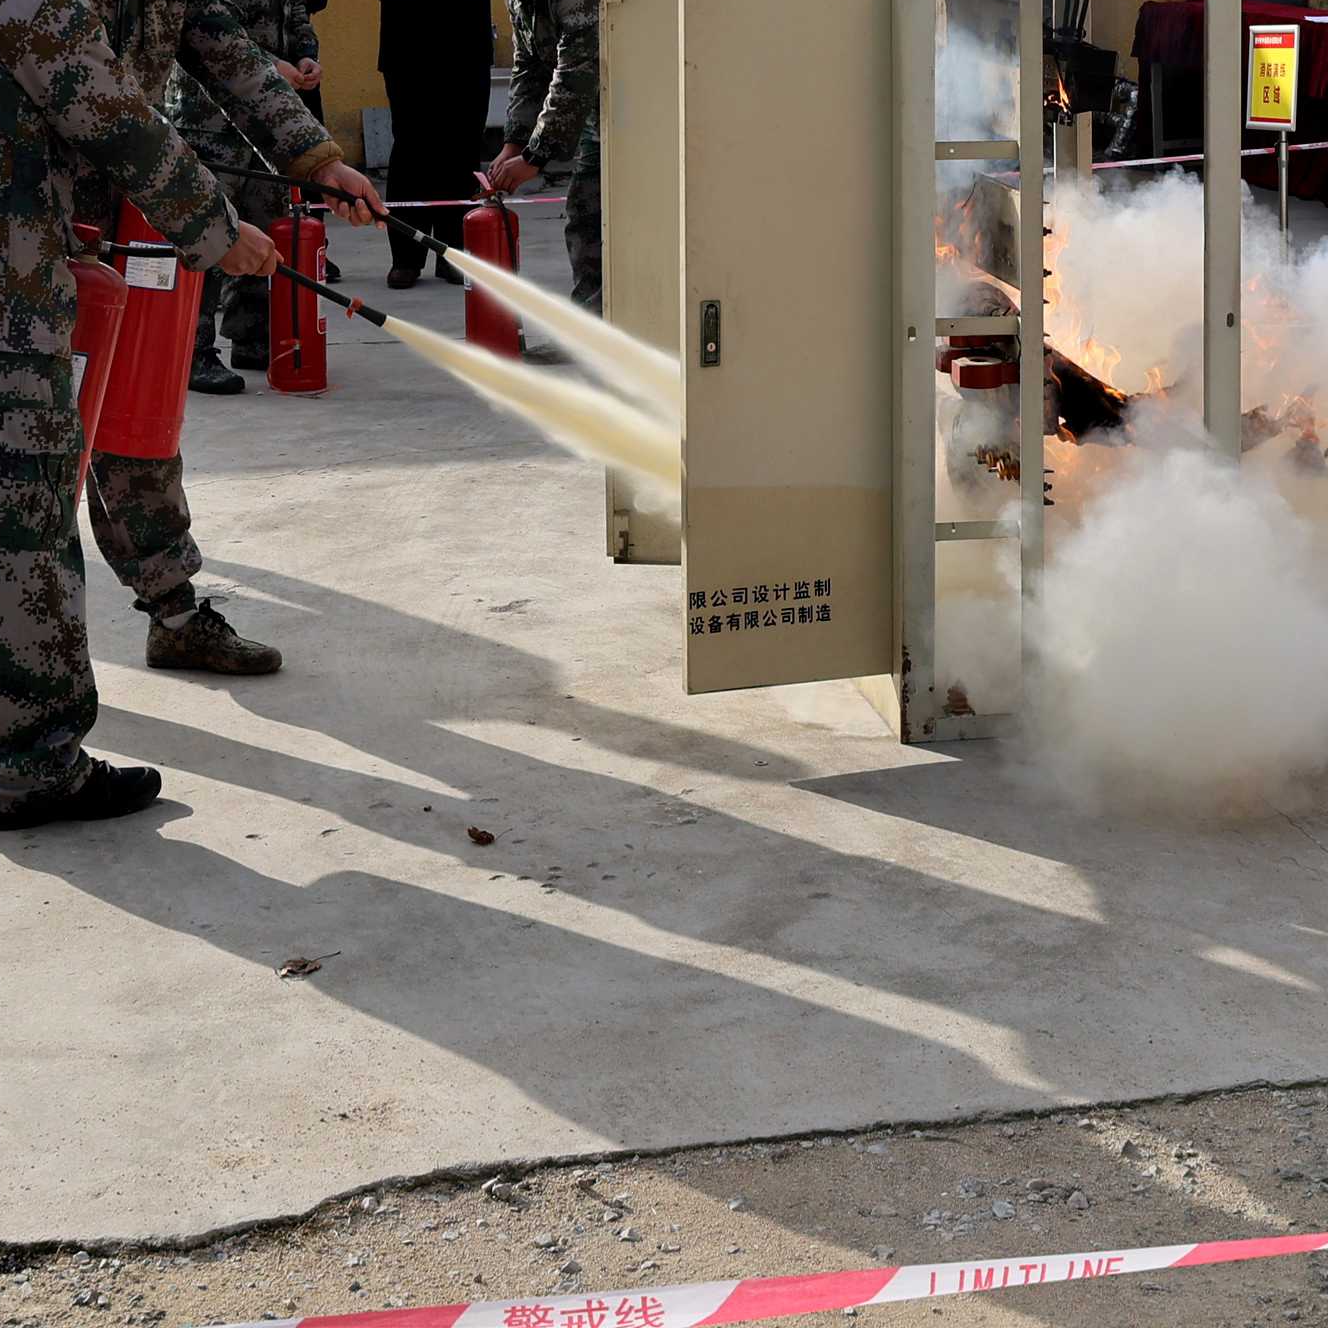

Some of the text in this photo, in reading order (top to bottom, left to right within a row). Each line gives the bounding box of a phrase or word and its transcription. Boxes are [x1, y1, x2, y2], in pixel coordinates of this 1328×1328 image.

[688, 578, 832, 609] 限公司设计监制
[688, 603, 832, 635] 设备有限公司制造
